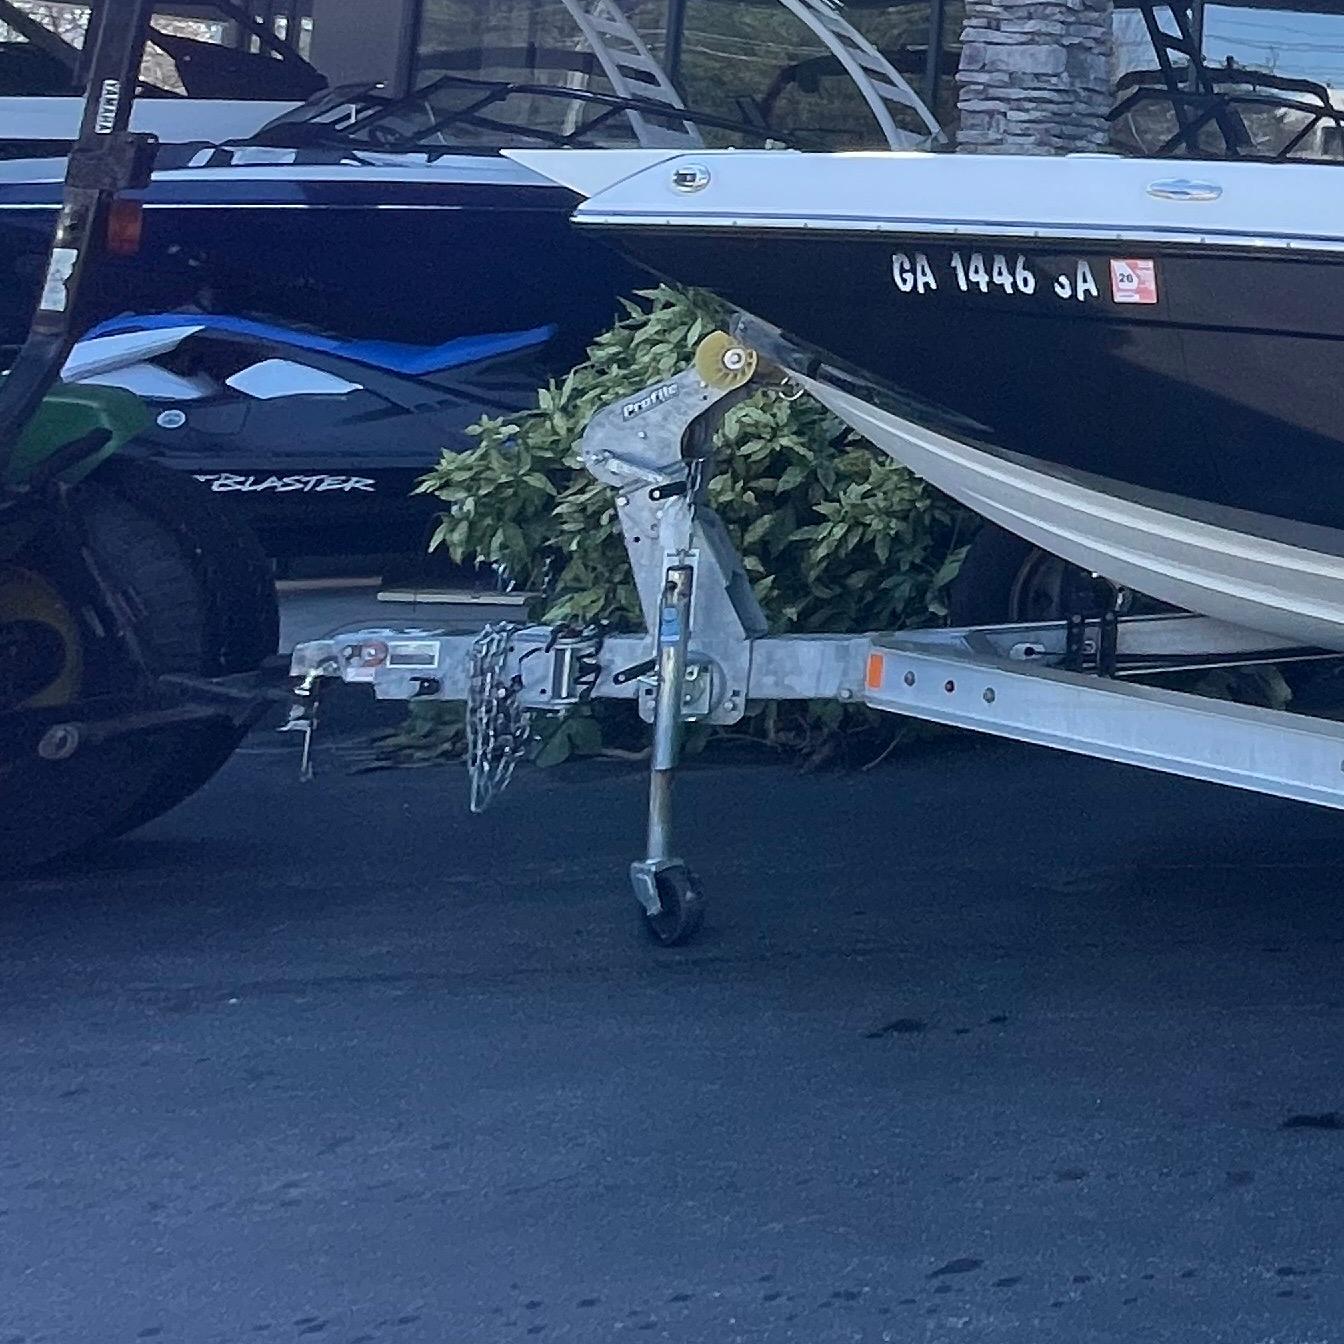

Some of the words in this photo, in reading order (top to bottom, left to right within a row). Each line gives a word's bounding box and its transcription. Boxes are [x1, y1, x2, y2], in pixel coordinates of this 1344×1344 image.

[95, 79, 121, 134] YAMAHA
[892, 253, 938, 294] GA
[951, 251, 1036, 294] 1446
